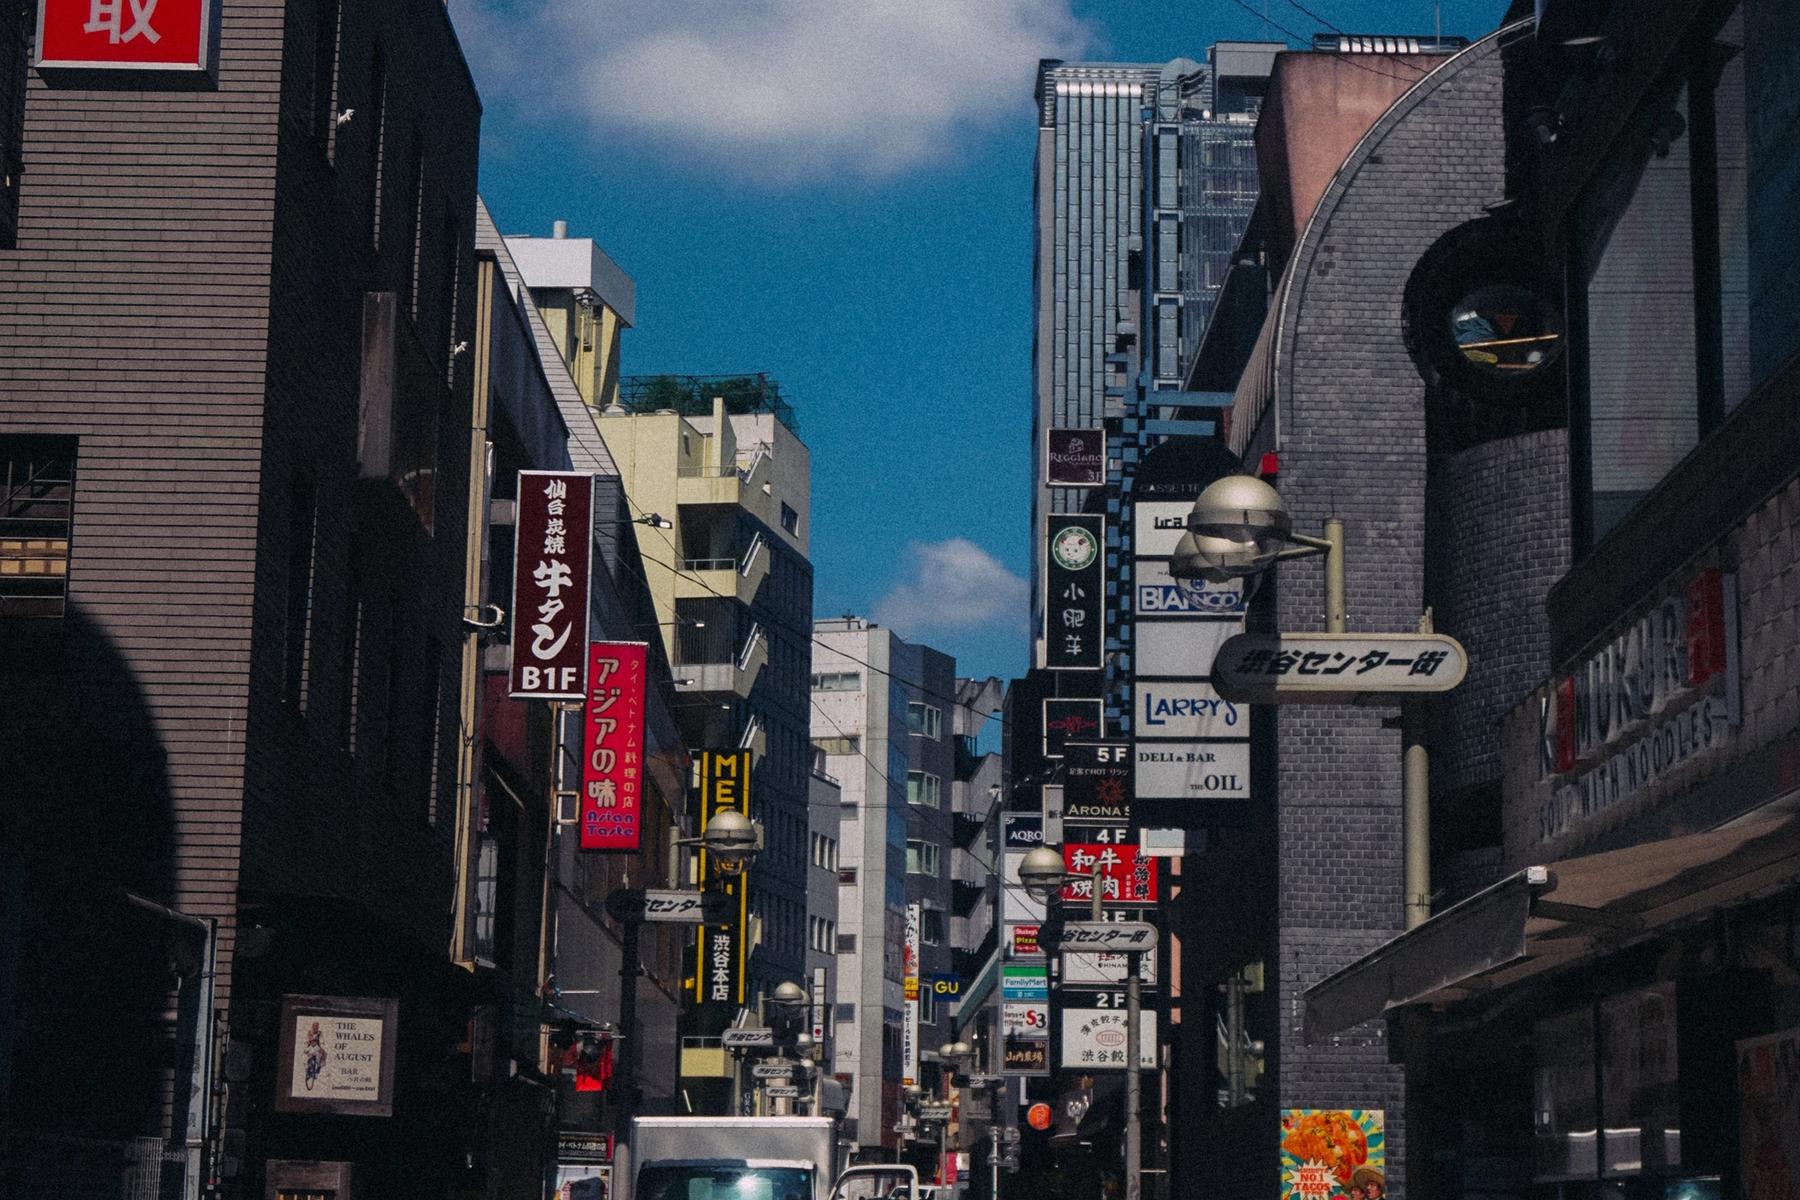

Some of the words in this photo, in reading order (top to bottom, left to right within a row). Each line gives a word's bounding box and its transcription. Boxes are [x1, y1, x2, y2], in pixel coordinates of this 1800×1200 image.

[83, 0, 162, 45] 取
[532, 559, 574, 661] 牛タン
[1062, 582, 1086, 656] 小肥羊
[1233, 650, 1449, 677] 渋谷センター街
[521, 666, 577, 691] B1F
[588, 658, 621, 808] アジアの味
[1627, 697, 1714, 792] NOODLES
[1097, 747, 1127, 762] 5F
[1140, 753, 1174, 762] DELI
[1186, 753, 1216, 762] BAR
[1204, 774, 1243, 791] OIL
[587, 811, 634, 824] Asian
[1068, 803, 1122, 817] ARONA
[587, 825, 634, 837] Taste
[1097, 829, 1127, 844] 4F
[1071, 847, 1122, 872] 和牛
[1071, 875, 1120, 900] 焼肉
[712, 934, 731, 1001] 渋谷本店
[935, 980, 959, 994] GU
[1005, 978, 1046, 987] FamilyMart
[1096, 993, 1126, 1008] 2F
[336, 1022, 357, 1031] THE
[335, 1032, 375, 1041] WHALES
[334, 1042, 348, 1051] OF
[335, 1053, 373, 1062] AUGUST
[341, 1068, 359, 1076] BAR
[1294, 1183, 1331, 1191] TACOS
